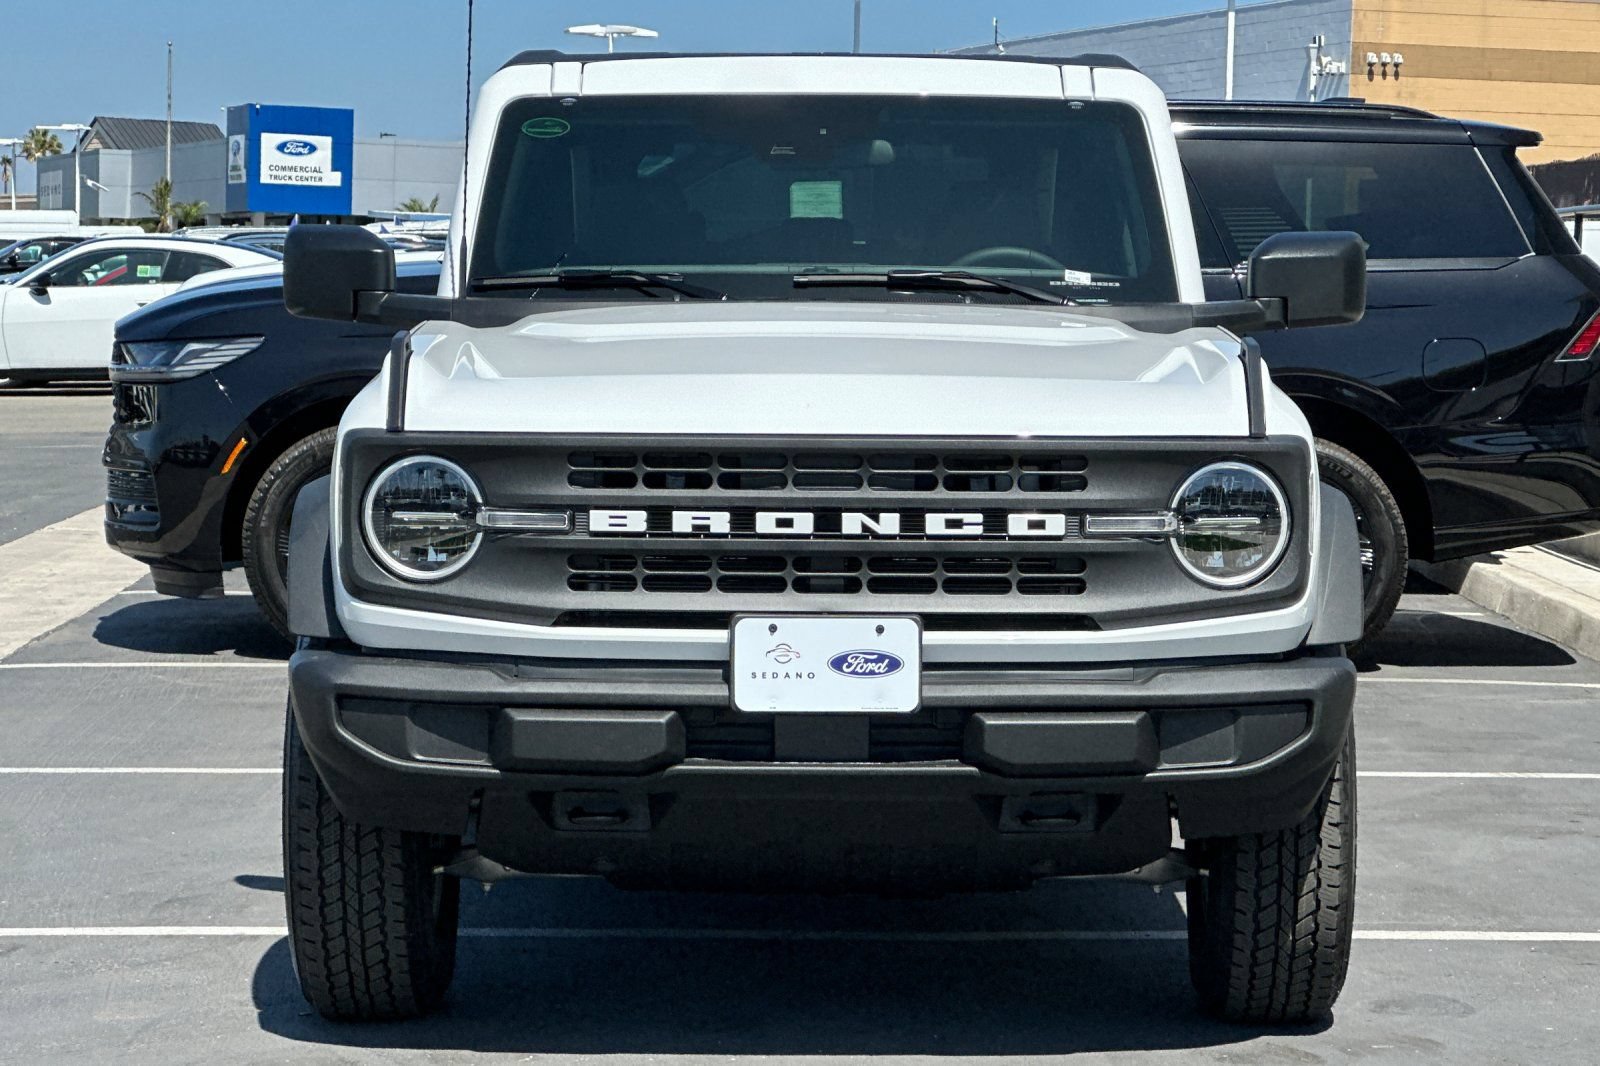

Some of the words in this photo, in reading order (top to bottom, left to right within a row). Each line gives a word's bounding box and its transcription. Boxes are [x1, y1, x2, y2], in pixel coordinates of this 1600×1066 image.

[283, 141, 310, 154] Ford
[268, 164, 323, 174] COMMERCIAL
[269, 174, 293, 182] TRUCK
[294, 175, 323, 183] CENTER
[589, 510, 1066, 536] BRONCO
[842, 653, 889, 674] Ford
[751, 671, 816, 680] SEDANO
